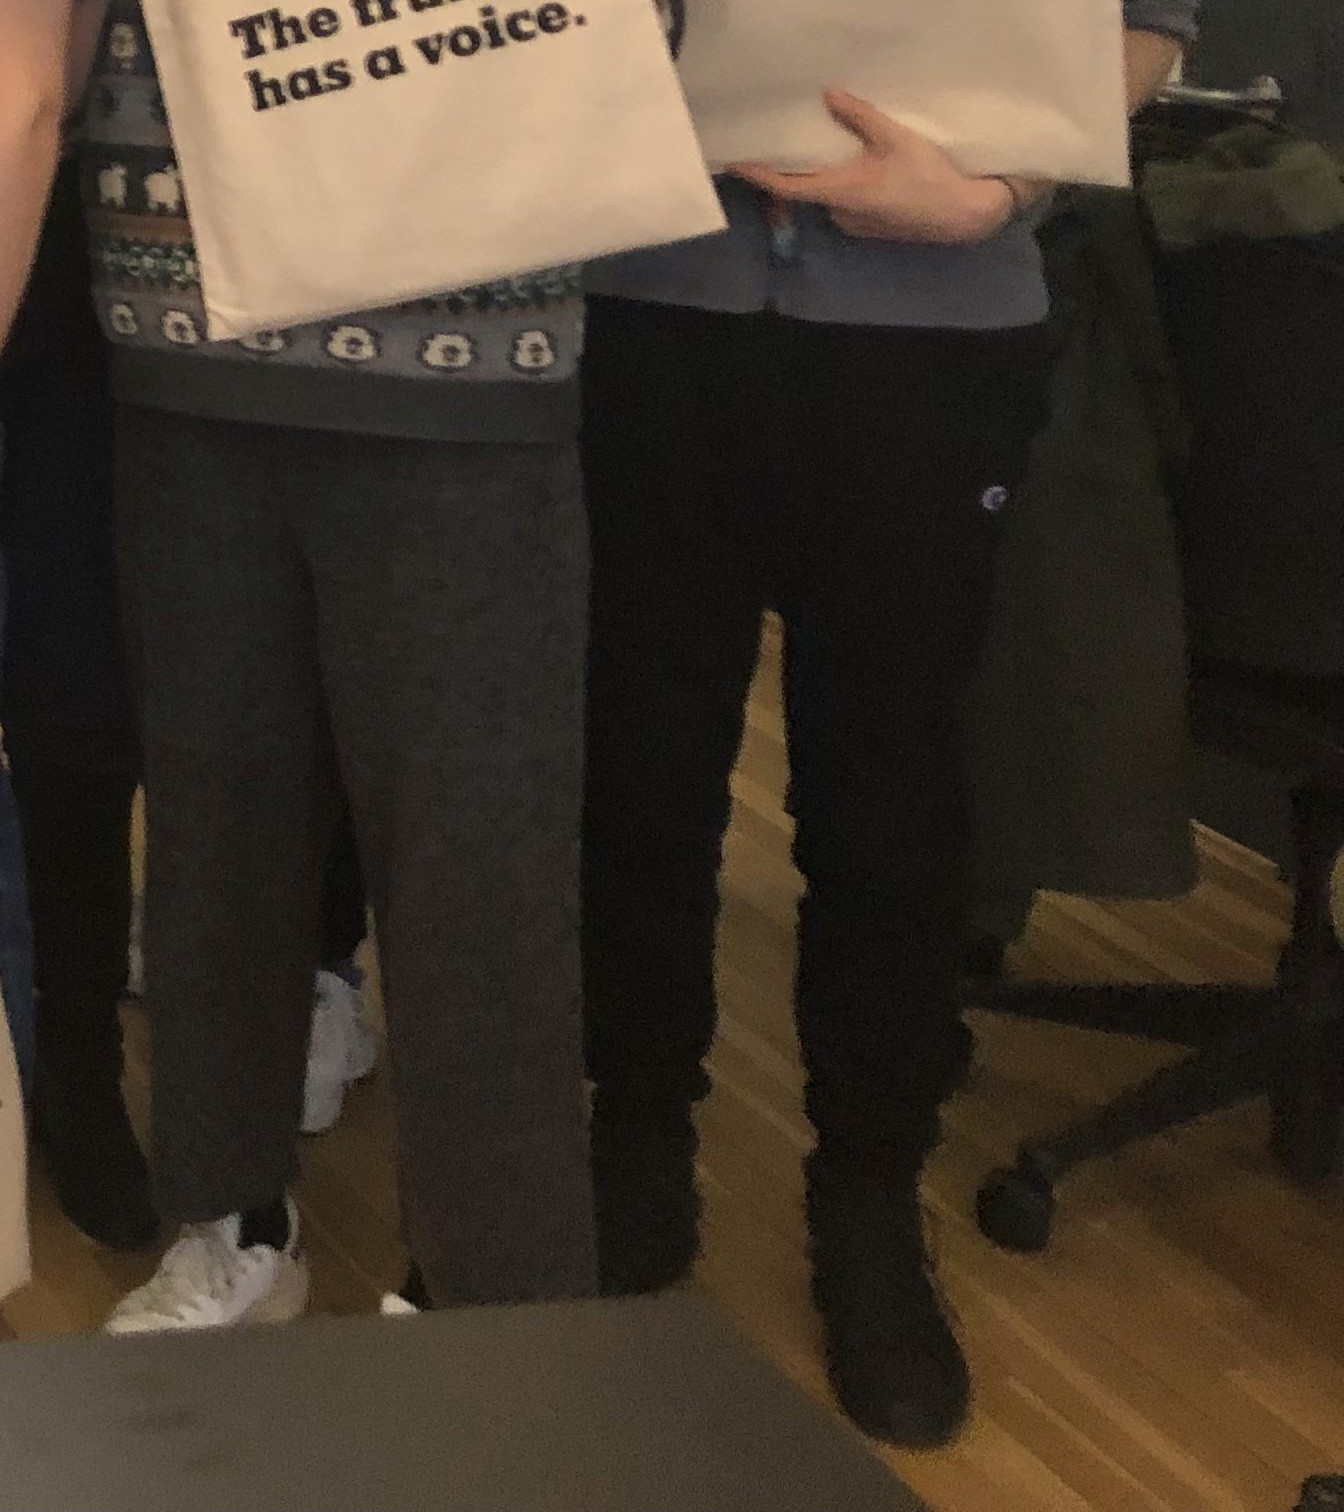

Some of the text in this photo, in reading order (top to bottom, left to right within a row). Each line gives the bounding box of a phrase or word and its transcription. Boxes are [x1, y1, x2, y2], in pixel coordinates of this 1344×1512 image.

[228, 6, 342, 60] The
[245, 1, 587, 112] has a voice.
